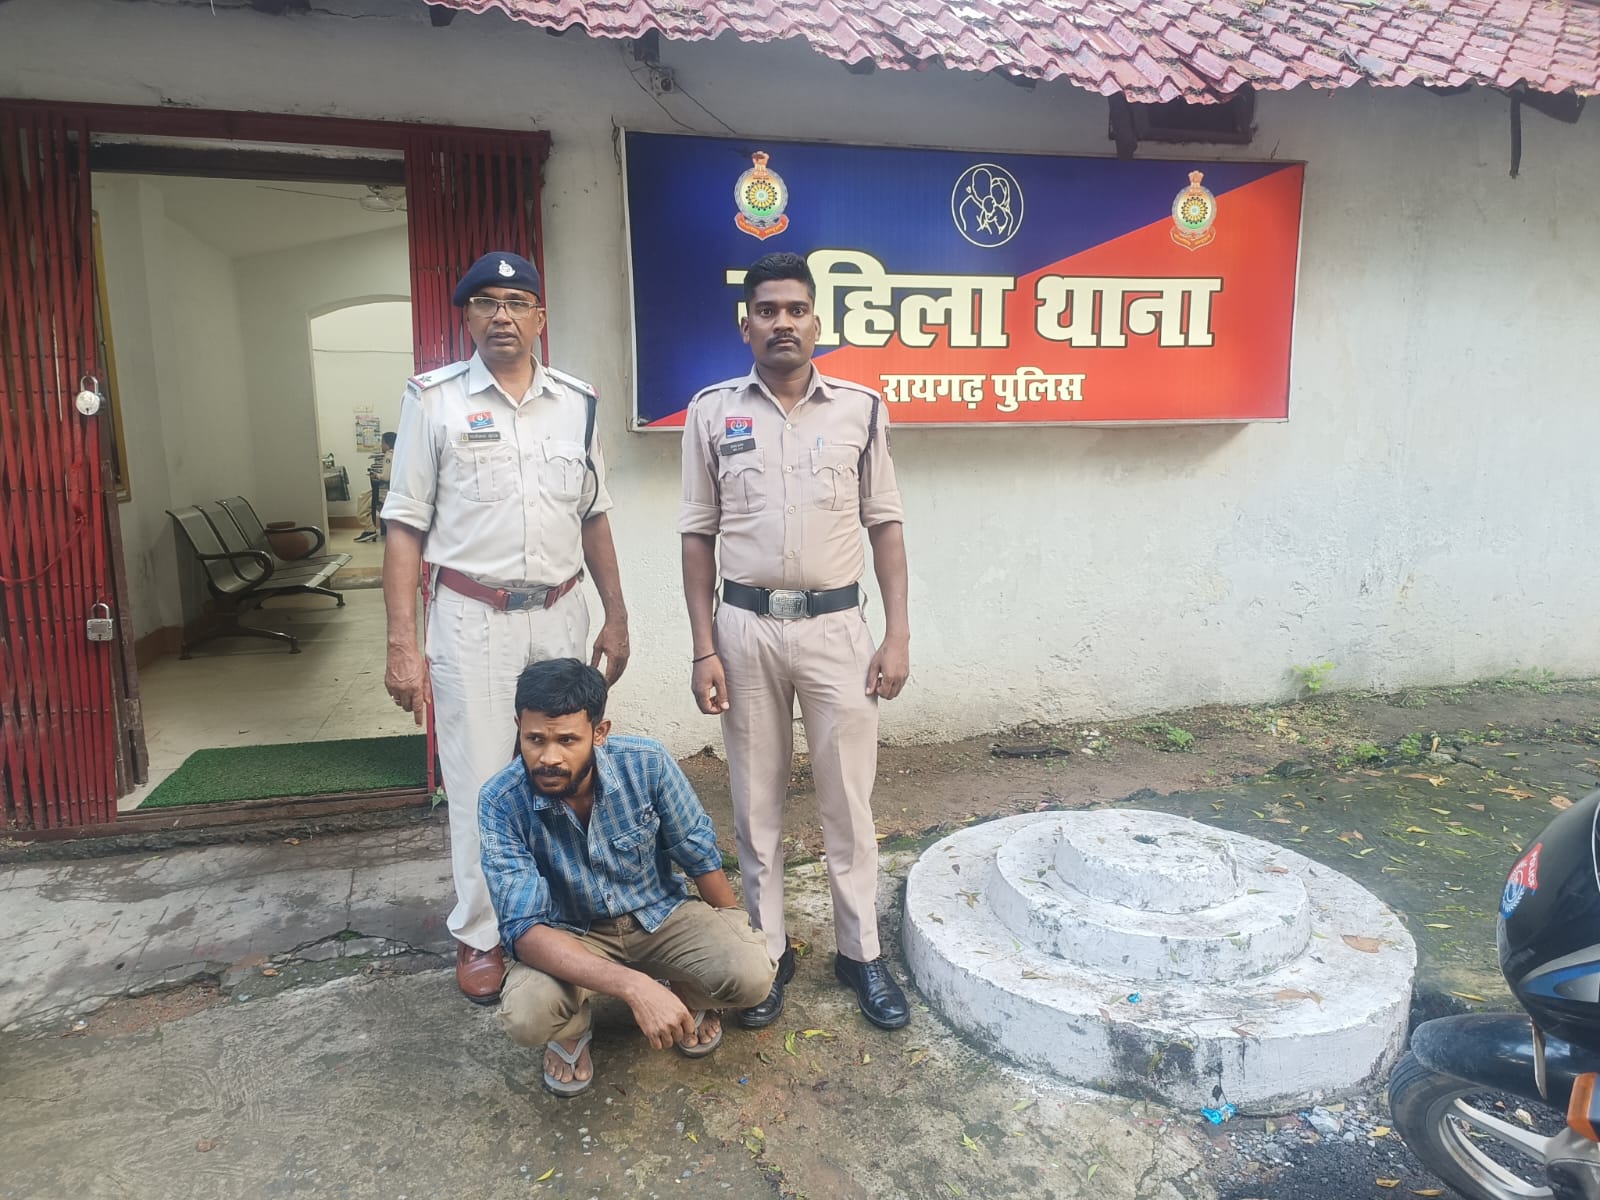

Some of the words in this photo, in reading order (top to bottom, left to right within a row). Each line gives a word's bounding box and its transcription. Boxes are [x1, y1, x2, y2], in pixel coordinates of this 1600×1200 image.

[726, 247, 1016, 349] हिला
[1035, 273, 1223, 348] थाना
[880, 373, 987, 409] रायगढ़
[991, 366, 1087, 413] पुलिस
